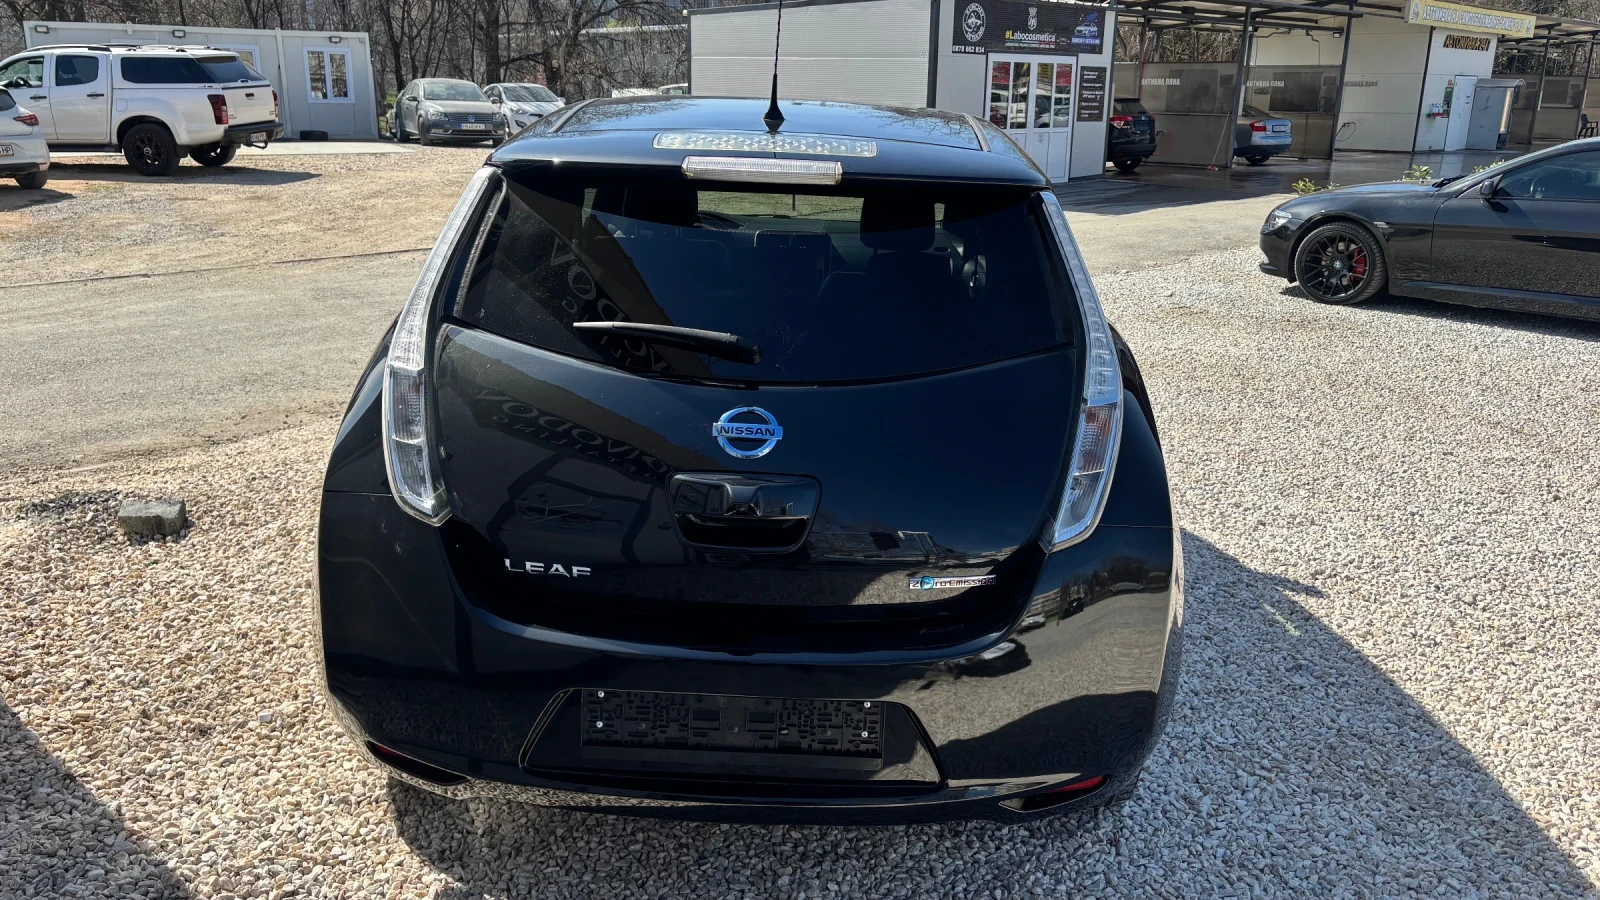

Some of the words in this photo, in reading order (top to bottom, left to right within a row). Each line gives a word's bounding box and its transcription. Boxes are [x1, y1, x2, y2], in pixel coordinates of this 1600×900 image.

[1005, 30, 1056, 42] #Labocosmetica
[1141, 78, 1164, 86] АКТИВНА
[1165, 78, 1181, 86] ПЯНА
[719, 425, 776, 437] NISSAN
[504, 558, 592, 578] LEAF
